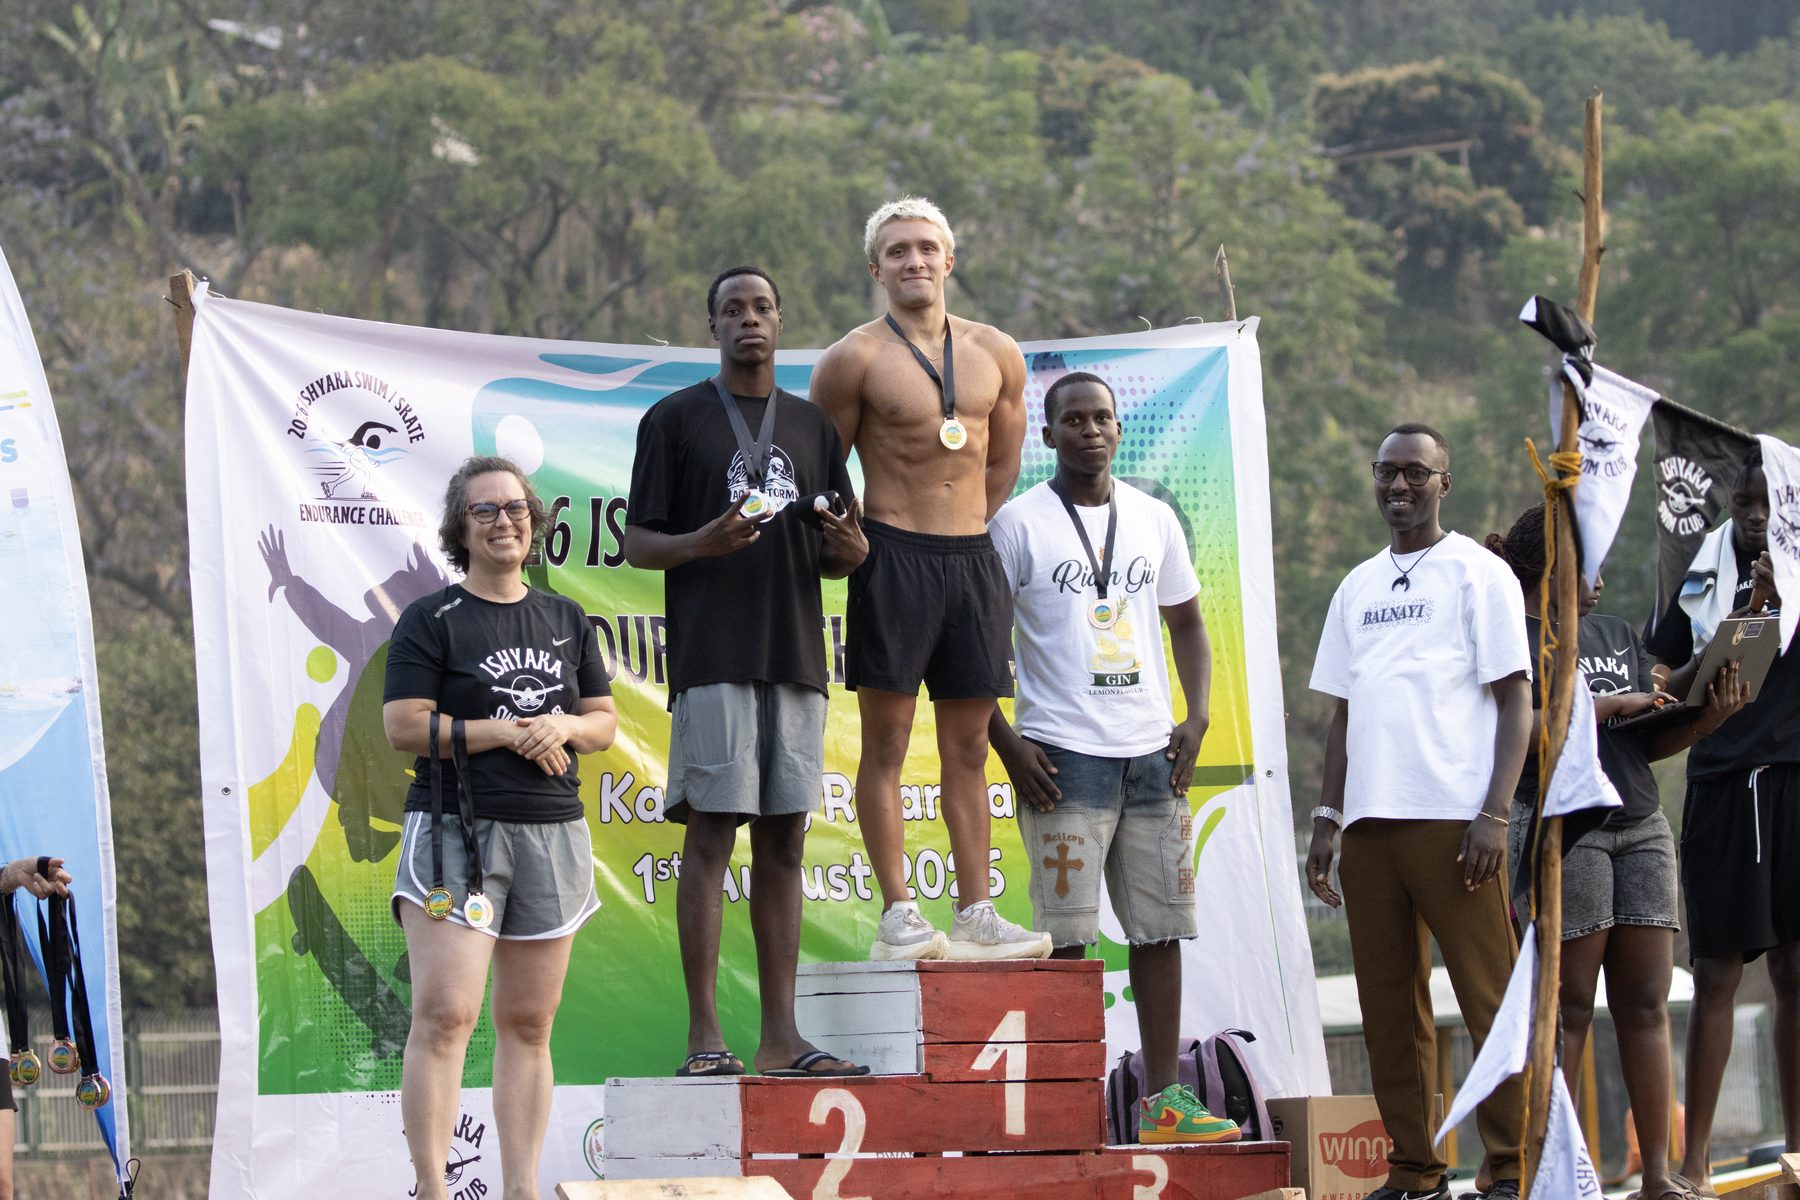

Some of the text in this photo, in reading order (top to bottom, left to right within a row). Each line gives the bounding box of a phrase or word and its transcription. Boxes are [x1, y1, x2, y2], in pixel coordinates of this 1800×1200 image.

[298, 370, 353, 410] ISHYAKA
[355, 371, 389, 400] SWIM
[394, 397, 425, 444] SKATE
[1660, 456, 1713, 496] ISHYAKA
[767, 487, 796, 499] TORM
[300, 503, 365, 525] ENDURANCE
[1678, 513, 1705, 536] CLUB
[1362, 604, 1425, 625] BALNAYI
[479, 647, 562, 680] ISHYAKA
[1105, 674, 1132, 686] GIN
[1089, 688, 1115, 696] LEMON
[970, 1010, 1028, 1136] 1
[808, 1087, 867, 1200] 2
